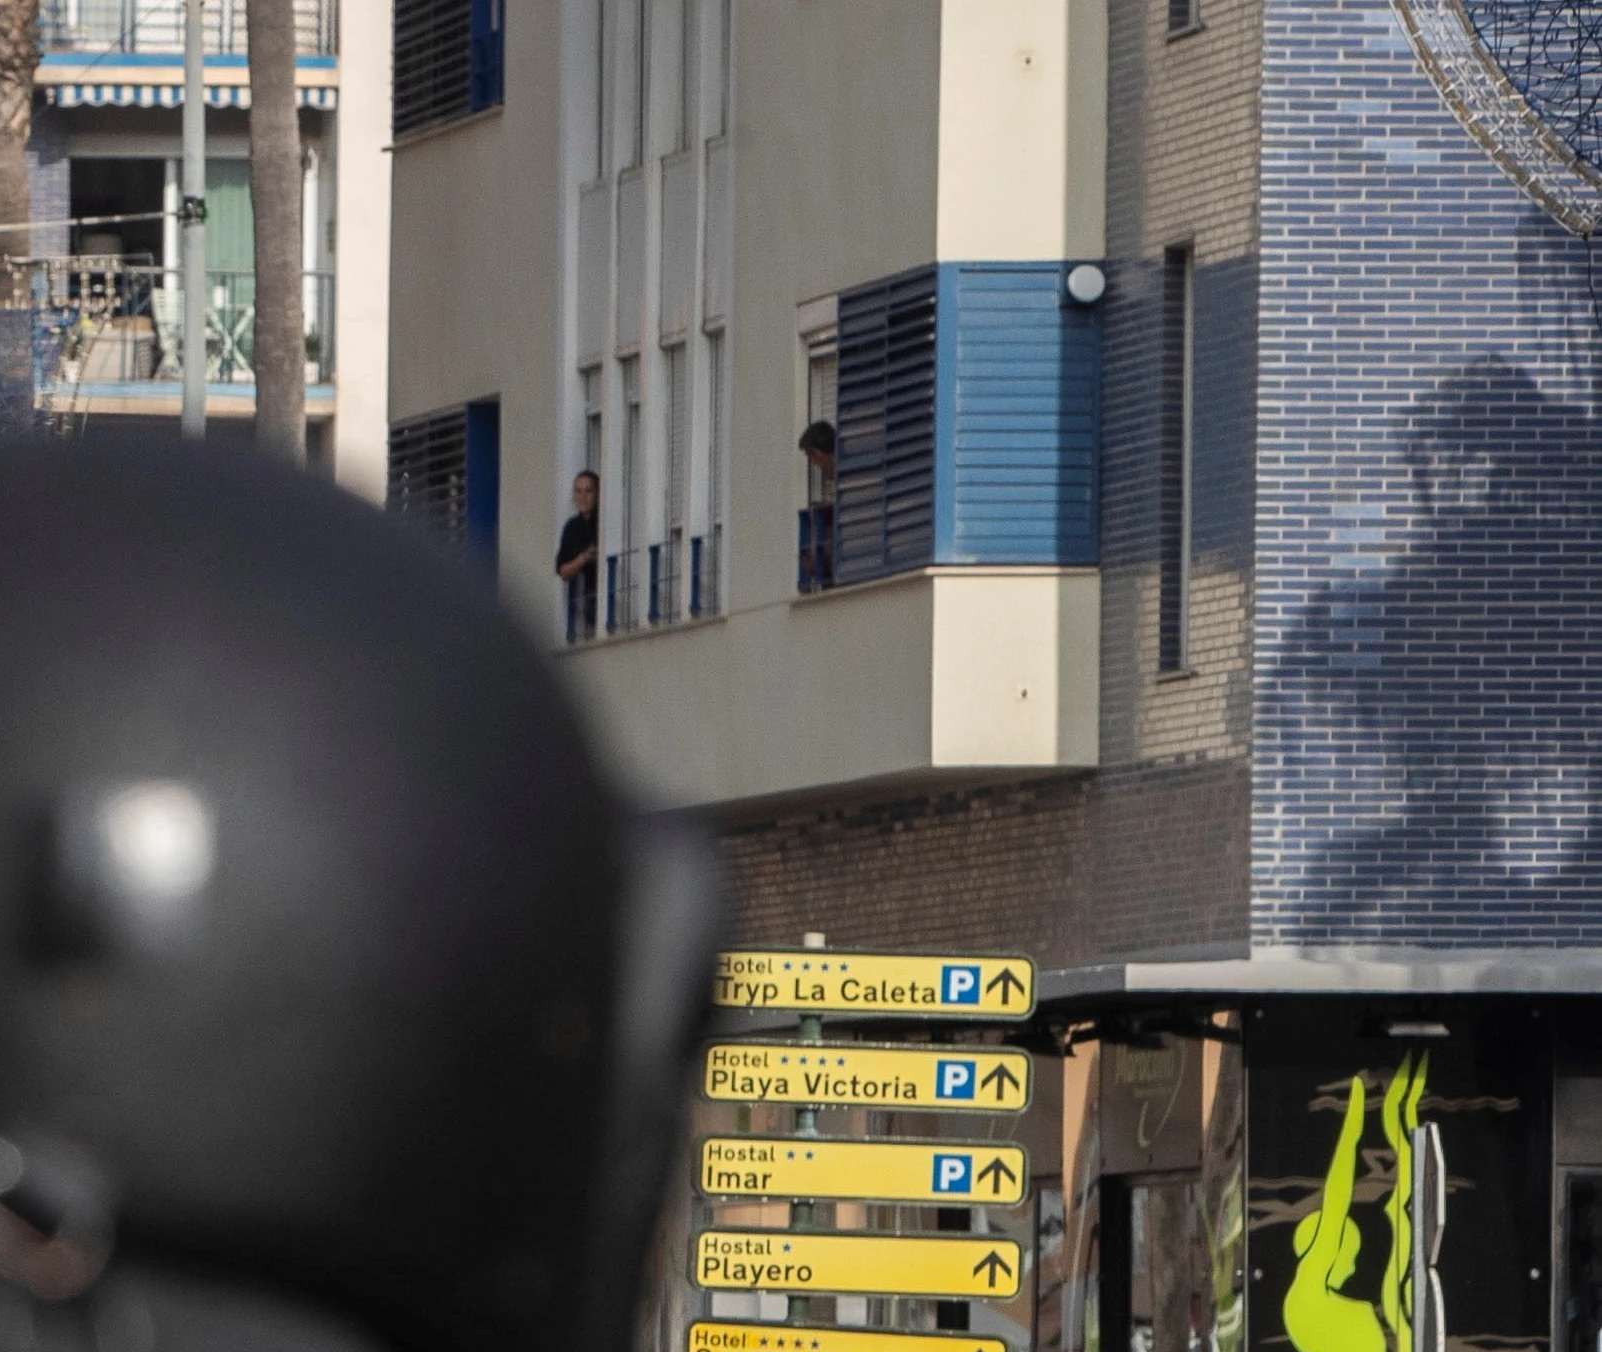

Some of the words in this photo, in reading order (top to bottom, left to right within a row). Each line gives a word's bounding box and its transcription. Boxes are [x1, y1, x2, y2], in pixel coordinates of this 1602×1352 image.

[718, 957, 773, 974] Hotel
[717, 976, 779, 1005] Tryp
[794, 979, 826, 1002] La
[840, 979, 937, 1004] Caleta
[712, 1050, 770, 1068] Hotel
[711, 1070, 790, 1099] Playa
[805, 1072, 917, 1099] Victoria
[707, 1145, 776, 1162] Hostal
[706, 1165, 772, 1190] Imar
[704, 1237, 772, 1255] Hostal
[702, 1256, 813, 1285] Playero
[695, 1330, 747, 1349] Hotel
